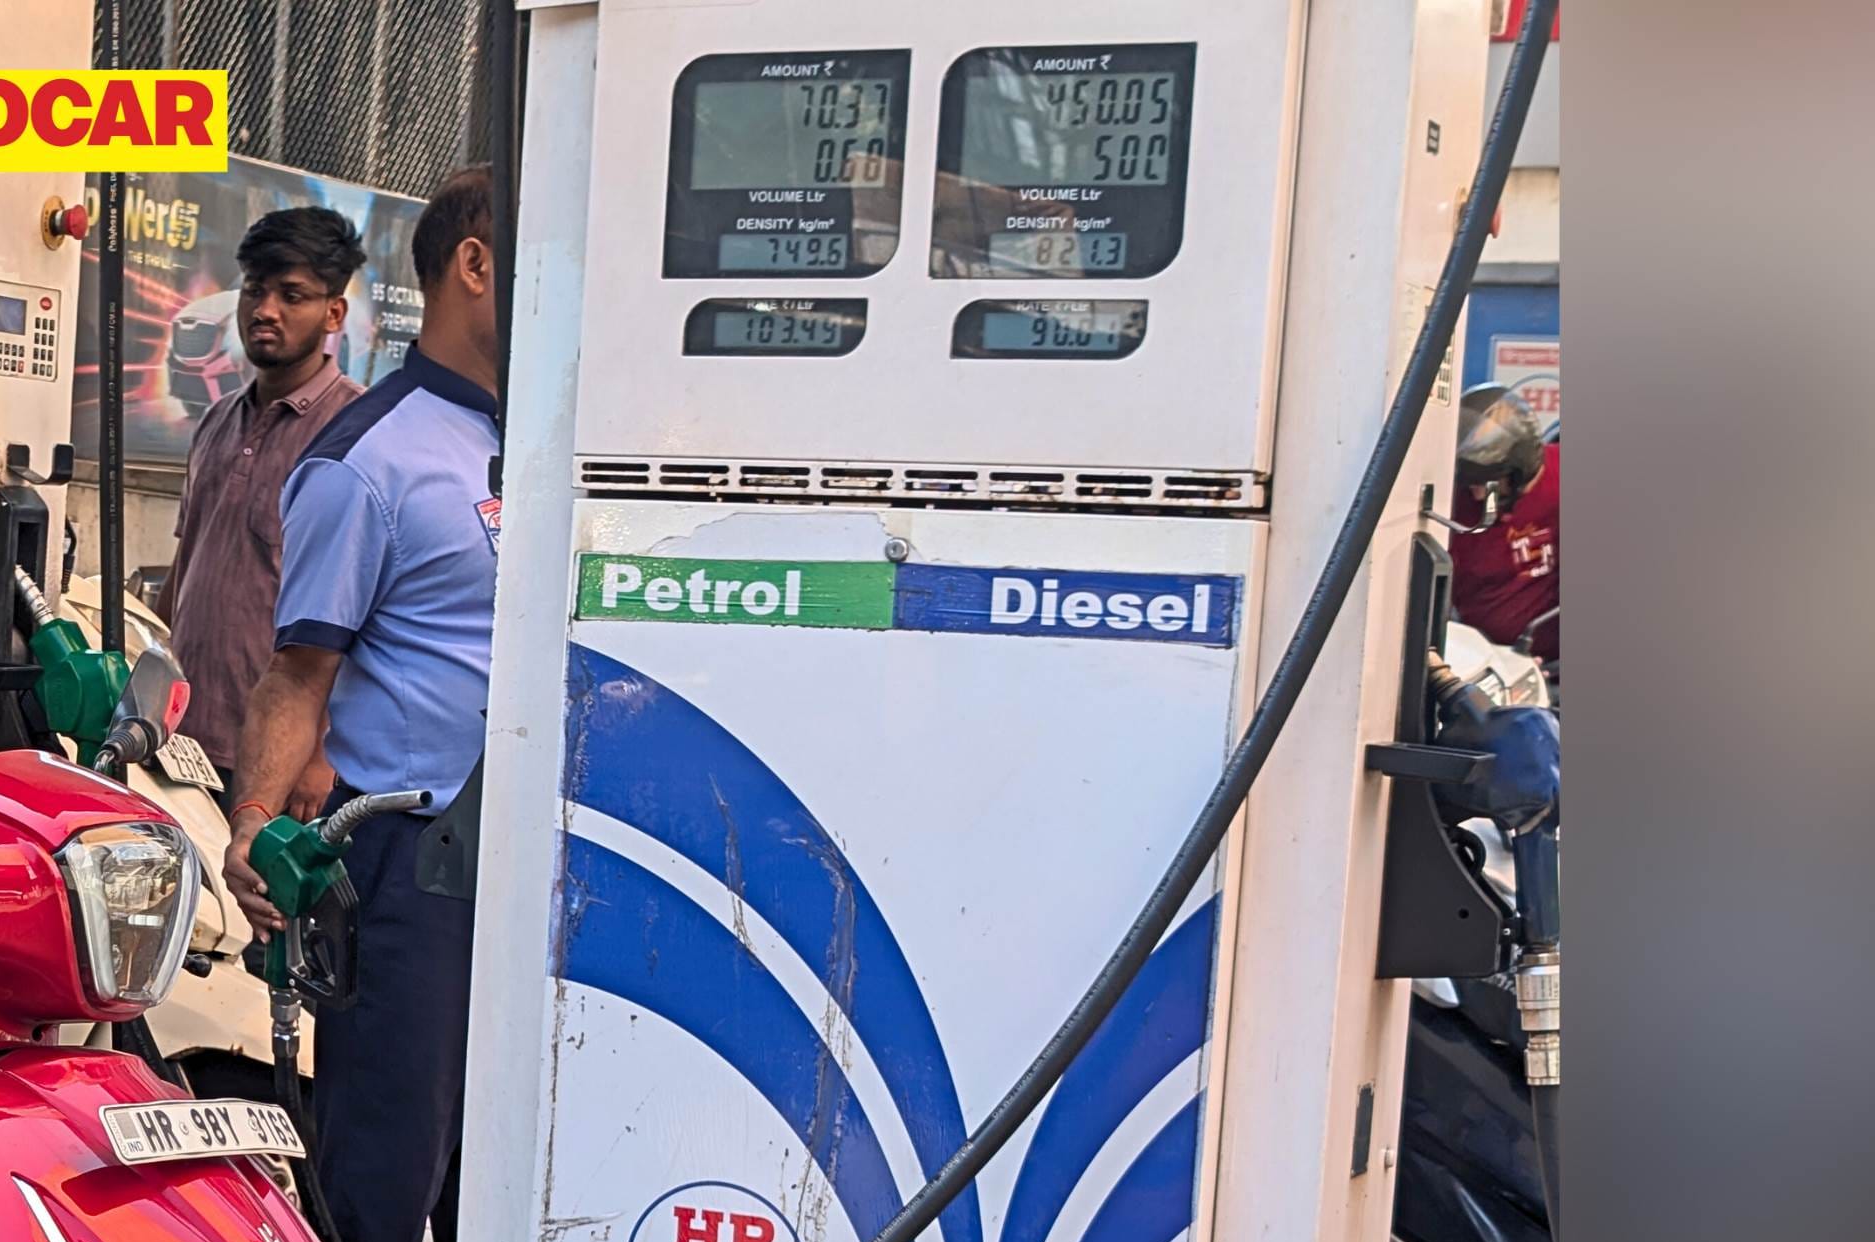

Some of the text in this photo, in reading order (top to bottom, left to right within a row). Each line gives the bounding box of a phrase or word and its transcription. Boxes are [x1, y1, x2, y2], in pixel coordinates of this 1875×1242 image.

[760, 64, 821, 77] AMOUNT
[1033, 58, 1096, 71] AMOUNT
[1047, 78, 1169, 125] 450.05
[749, 191, 804, 202] VOLUME
[1019, 189, 1078, 201] VOLUME
[736, 218, 794, 230] DENSITY
[1006, 217, 1068, 229] DENSITY
[768, 238, 842, 266] 749.6
[1036, 237, 1121, 266] 821.3
[599, 562, 801, 616] Petrol
[990, 578, 1210, 633] Diesel
[137, 1110, 182, 1152] HR
[190, 1106, 239, 1146] 98Y
[128, 1142, 143, 1153] IND
